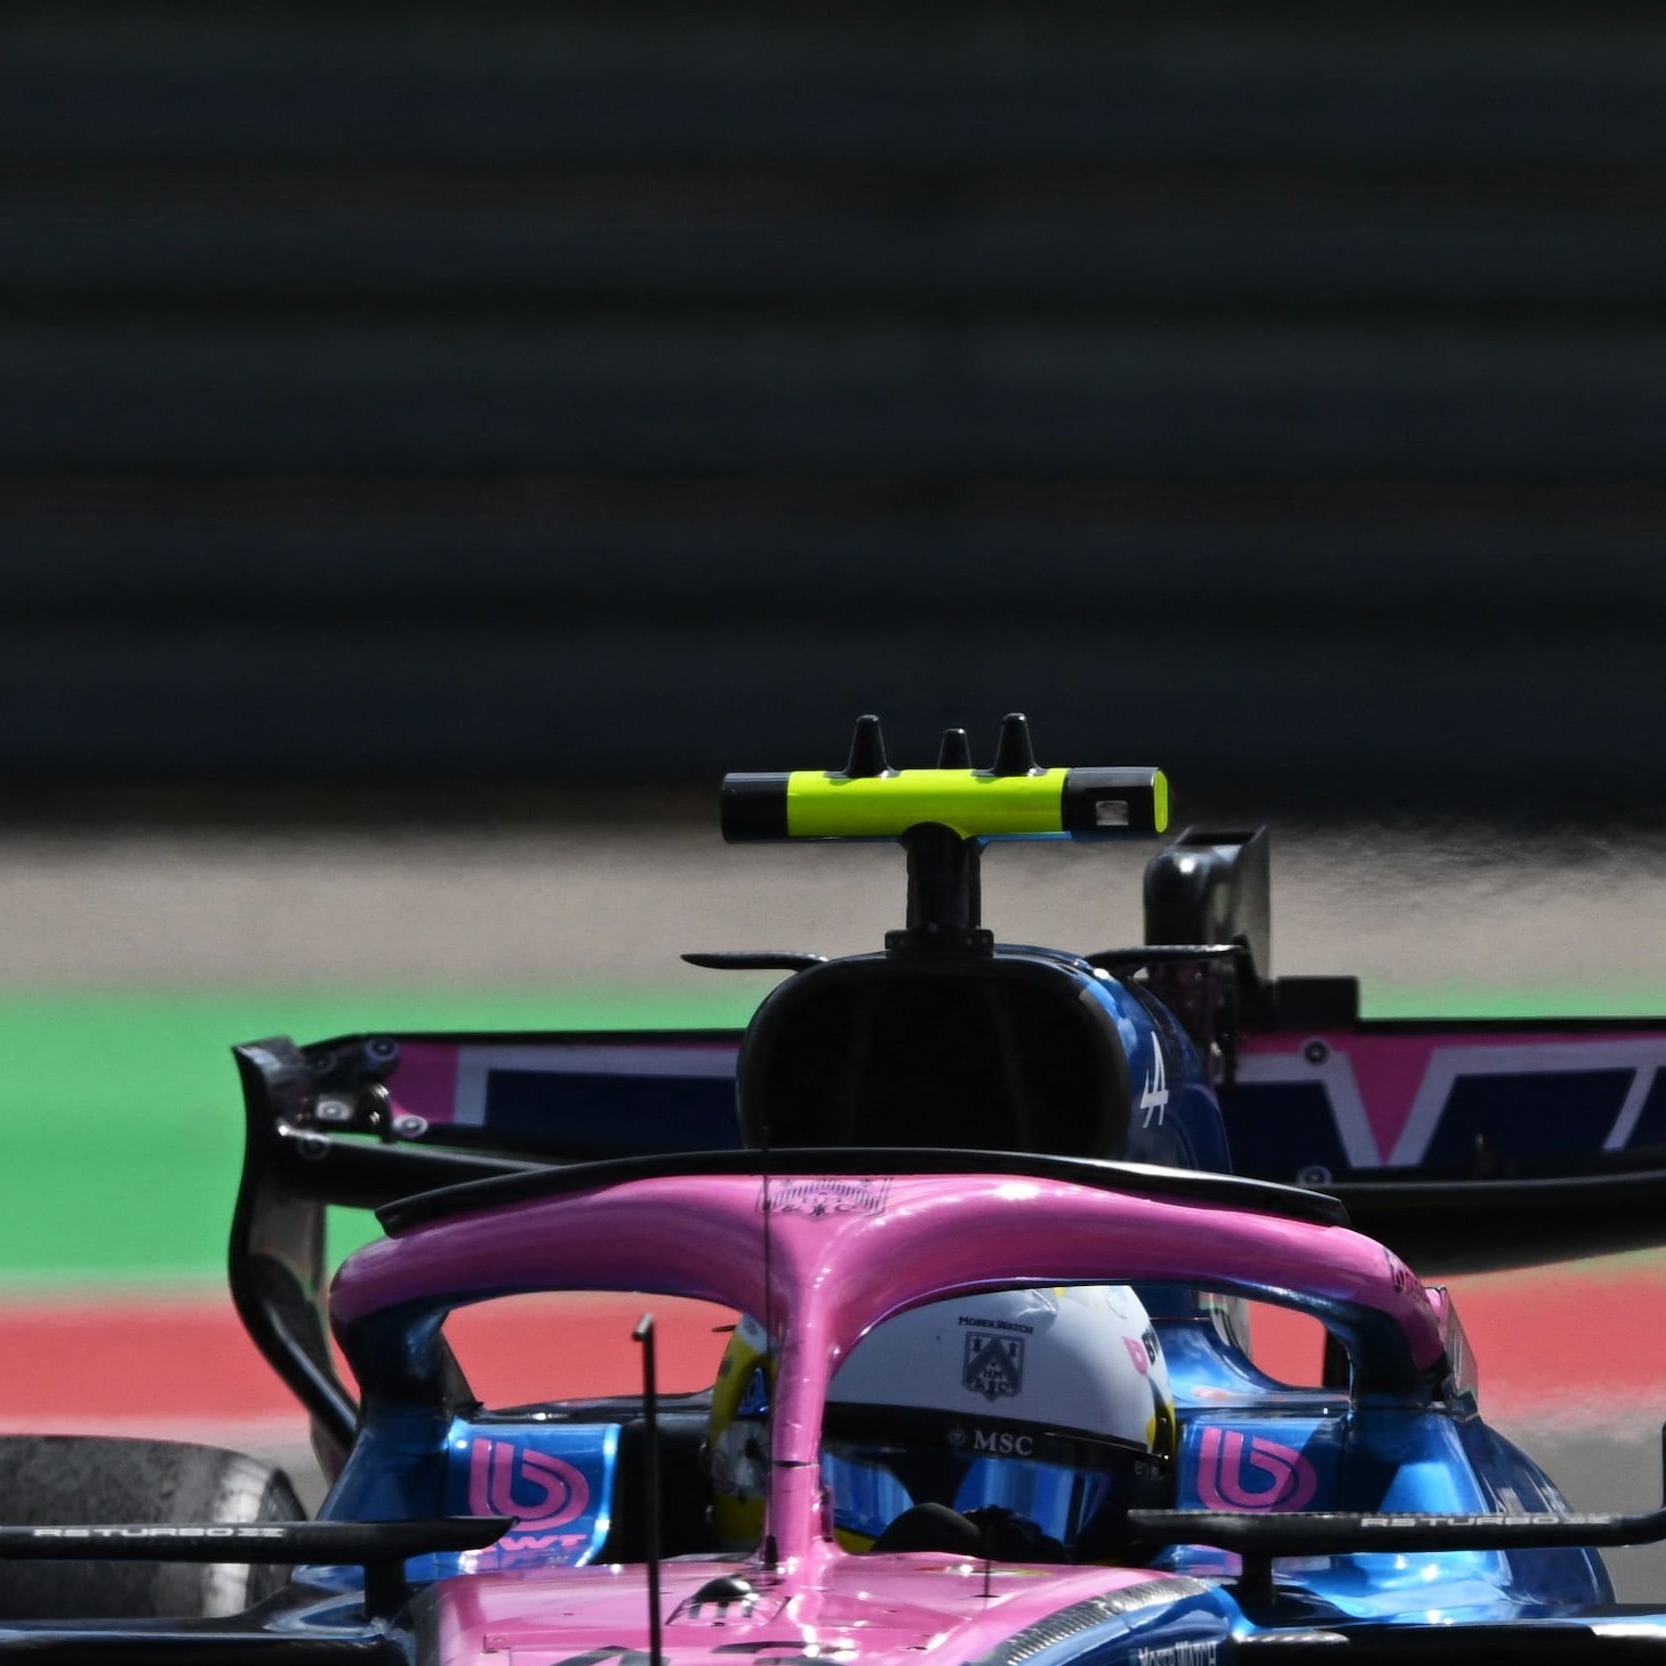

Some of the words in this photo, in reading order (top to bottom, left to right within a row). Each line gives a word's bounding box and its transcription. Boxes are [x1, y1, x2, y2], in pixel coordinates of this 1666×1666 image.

[973, 1430, 1033, 1456] MSC
[1421, 1515, 1560, 1527] TURBO
[93, 1527, 233, 1538] TURBO
[481, 1534, 587, 1554] WT
